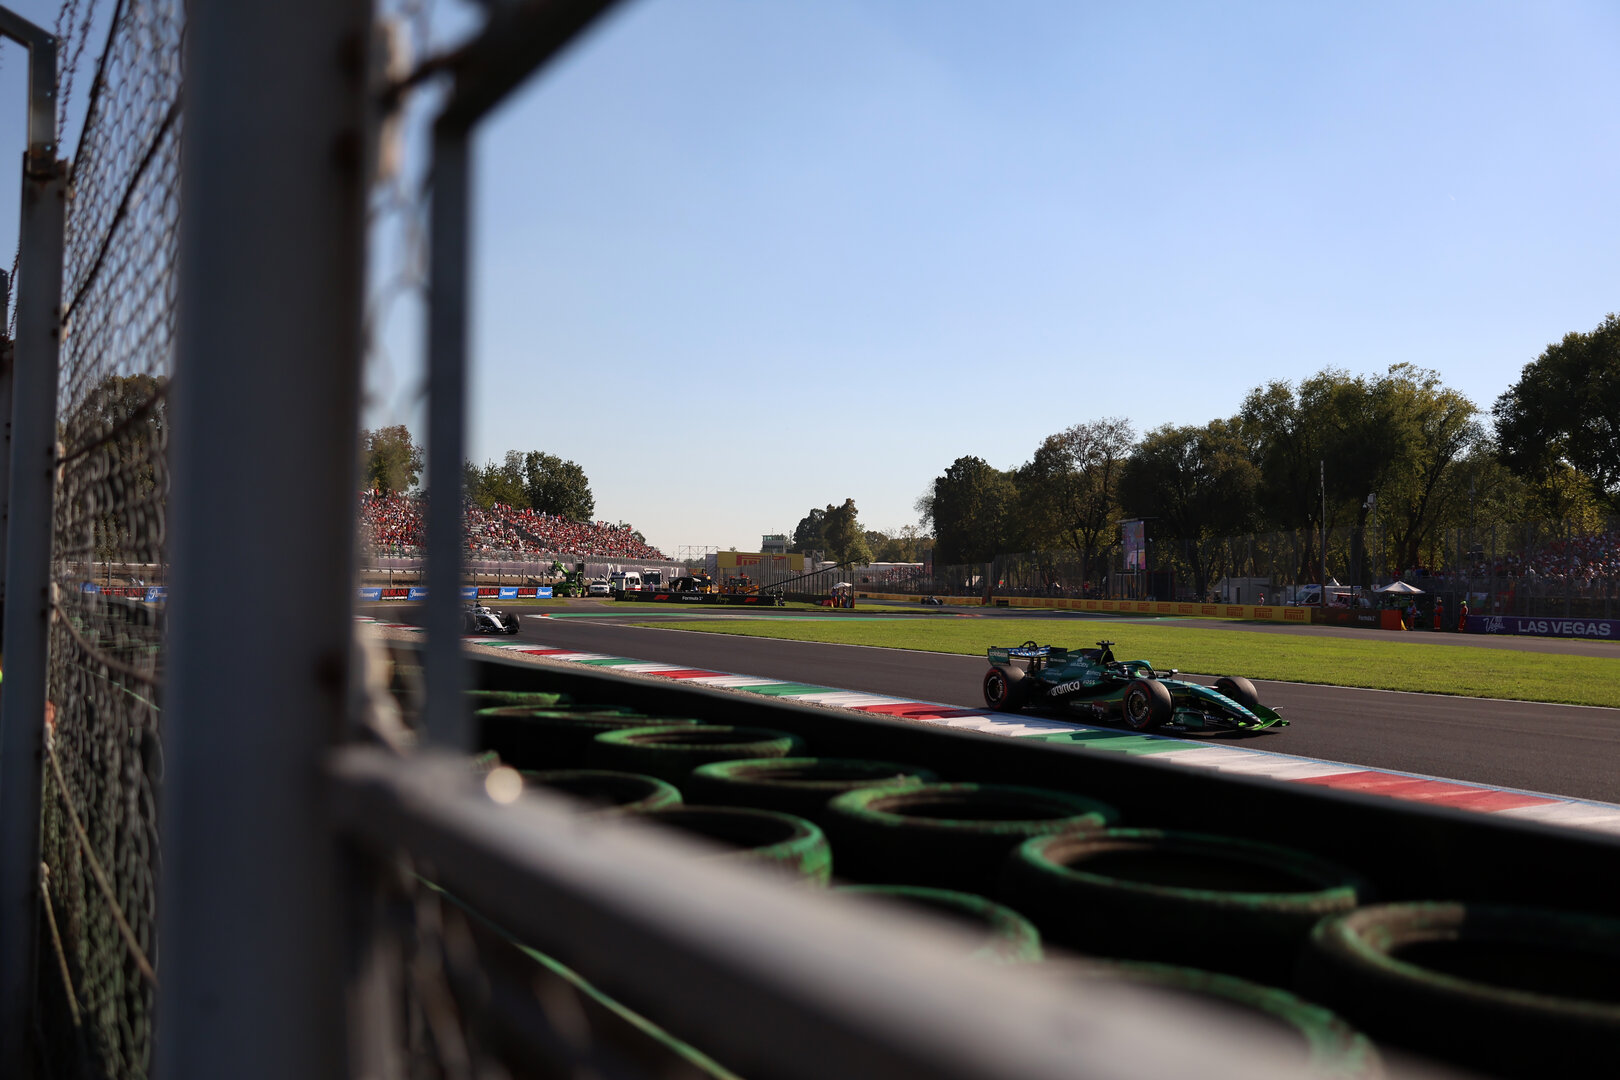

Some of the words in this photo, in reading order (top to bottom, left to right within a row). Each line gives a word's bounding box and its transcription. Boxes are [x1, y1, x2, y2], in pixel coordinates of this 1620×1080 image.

[1254, 607, 1272, 618] PIRELLI
[1284, 608, 1304, 620] PIRELLI
[1518, 620, 1548, 633] LAS
[1551, 621, 1611, 636] VEGAS
[1051, 681, 1080, 696] aramco
